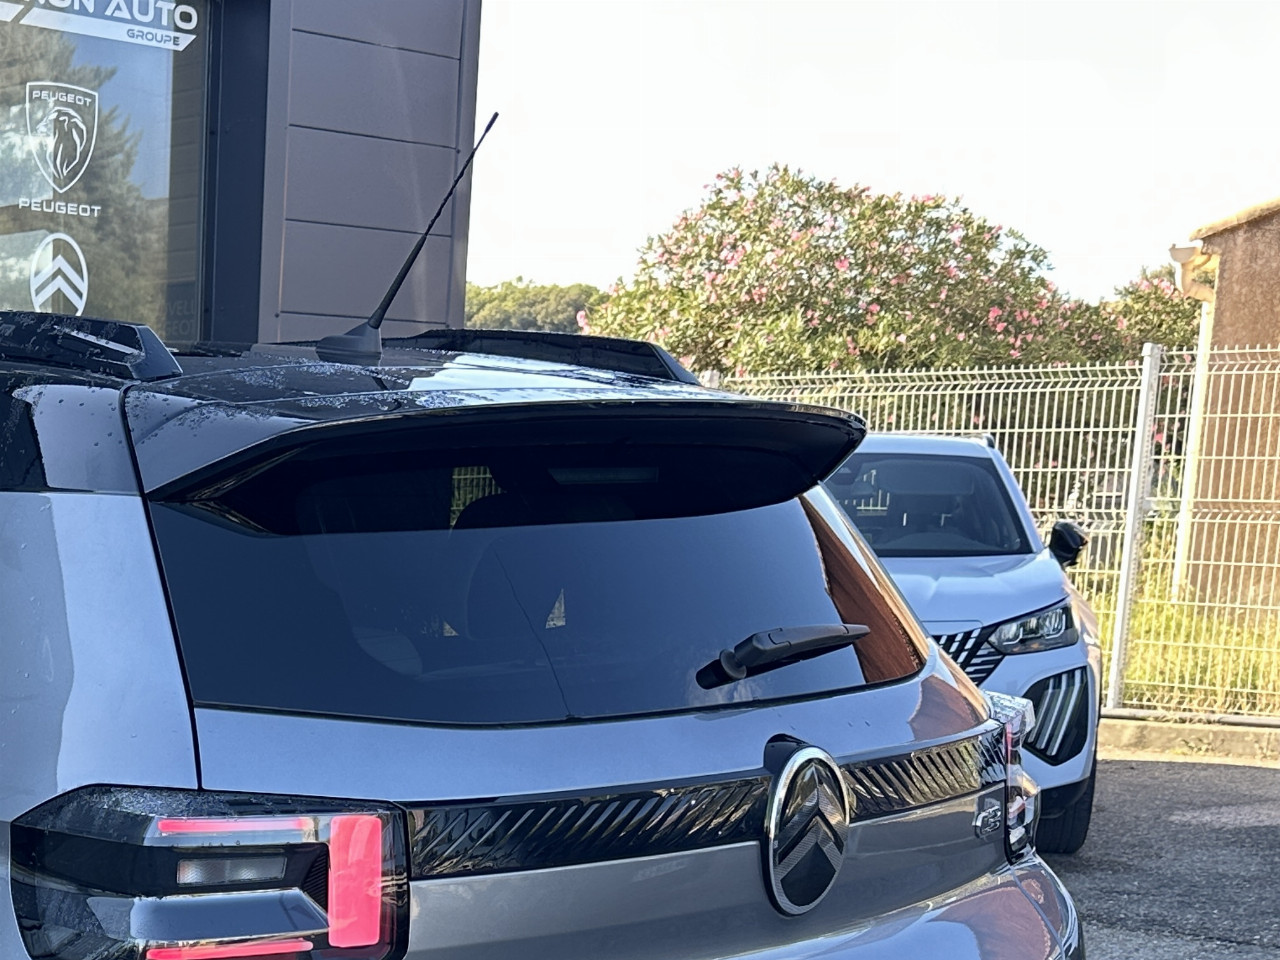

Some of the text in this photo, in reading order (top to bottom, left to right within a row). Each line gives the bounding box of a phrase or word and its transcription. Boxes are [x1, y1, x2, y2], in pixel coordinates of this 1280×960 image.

[104, 0, 198, 30] AUTO
[126, 28, 180, 46] GROUPE
[32, 90, 92, 107] PEUGEOT
[18, 198, 102, 217] PEUGEOT
